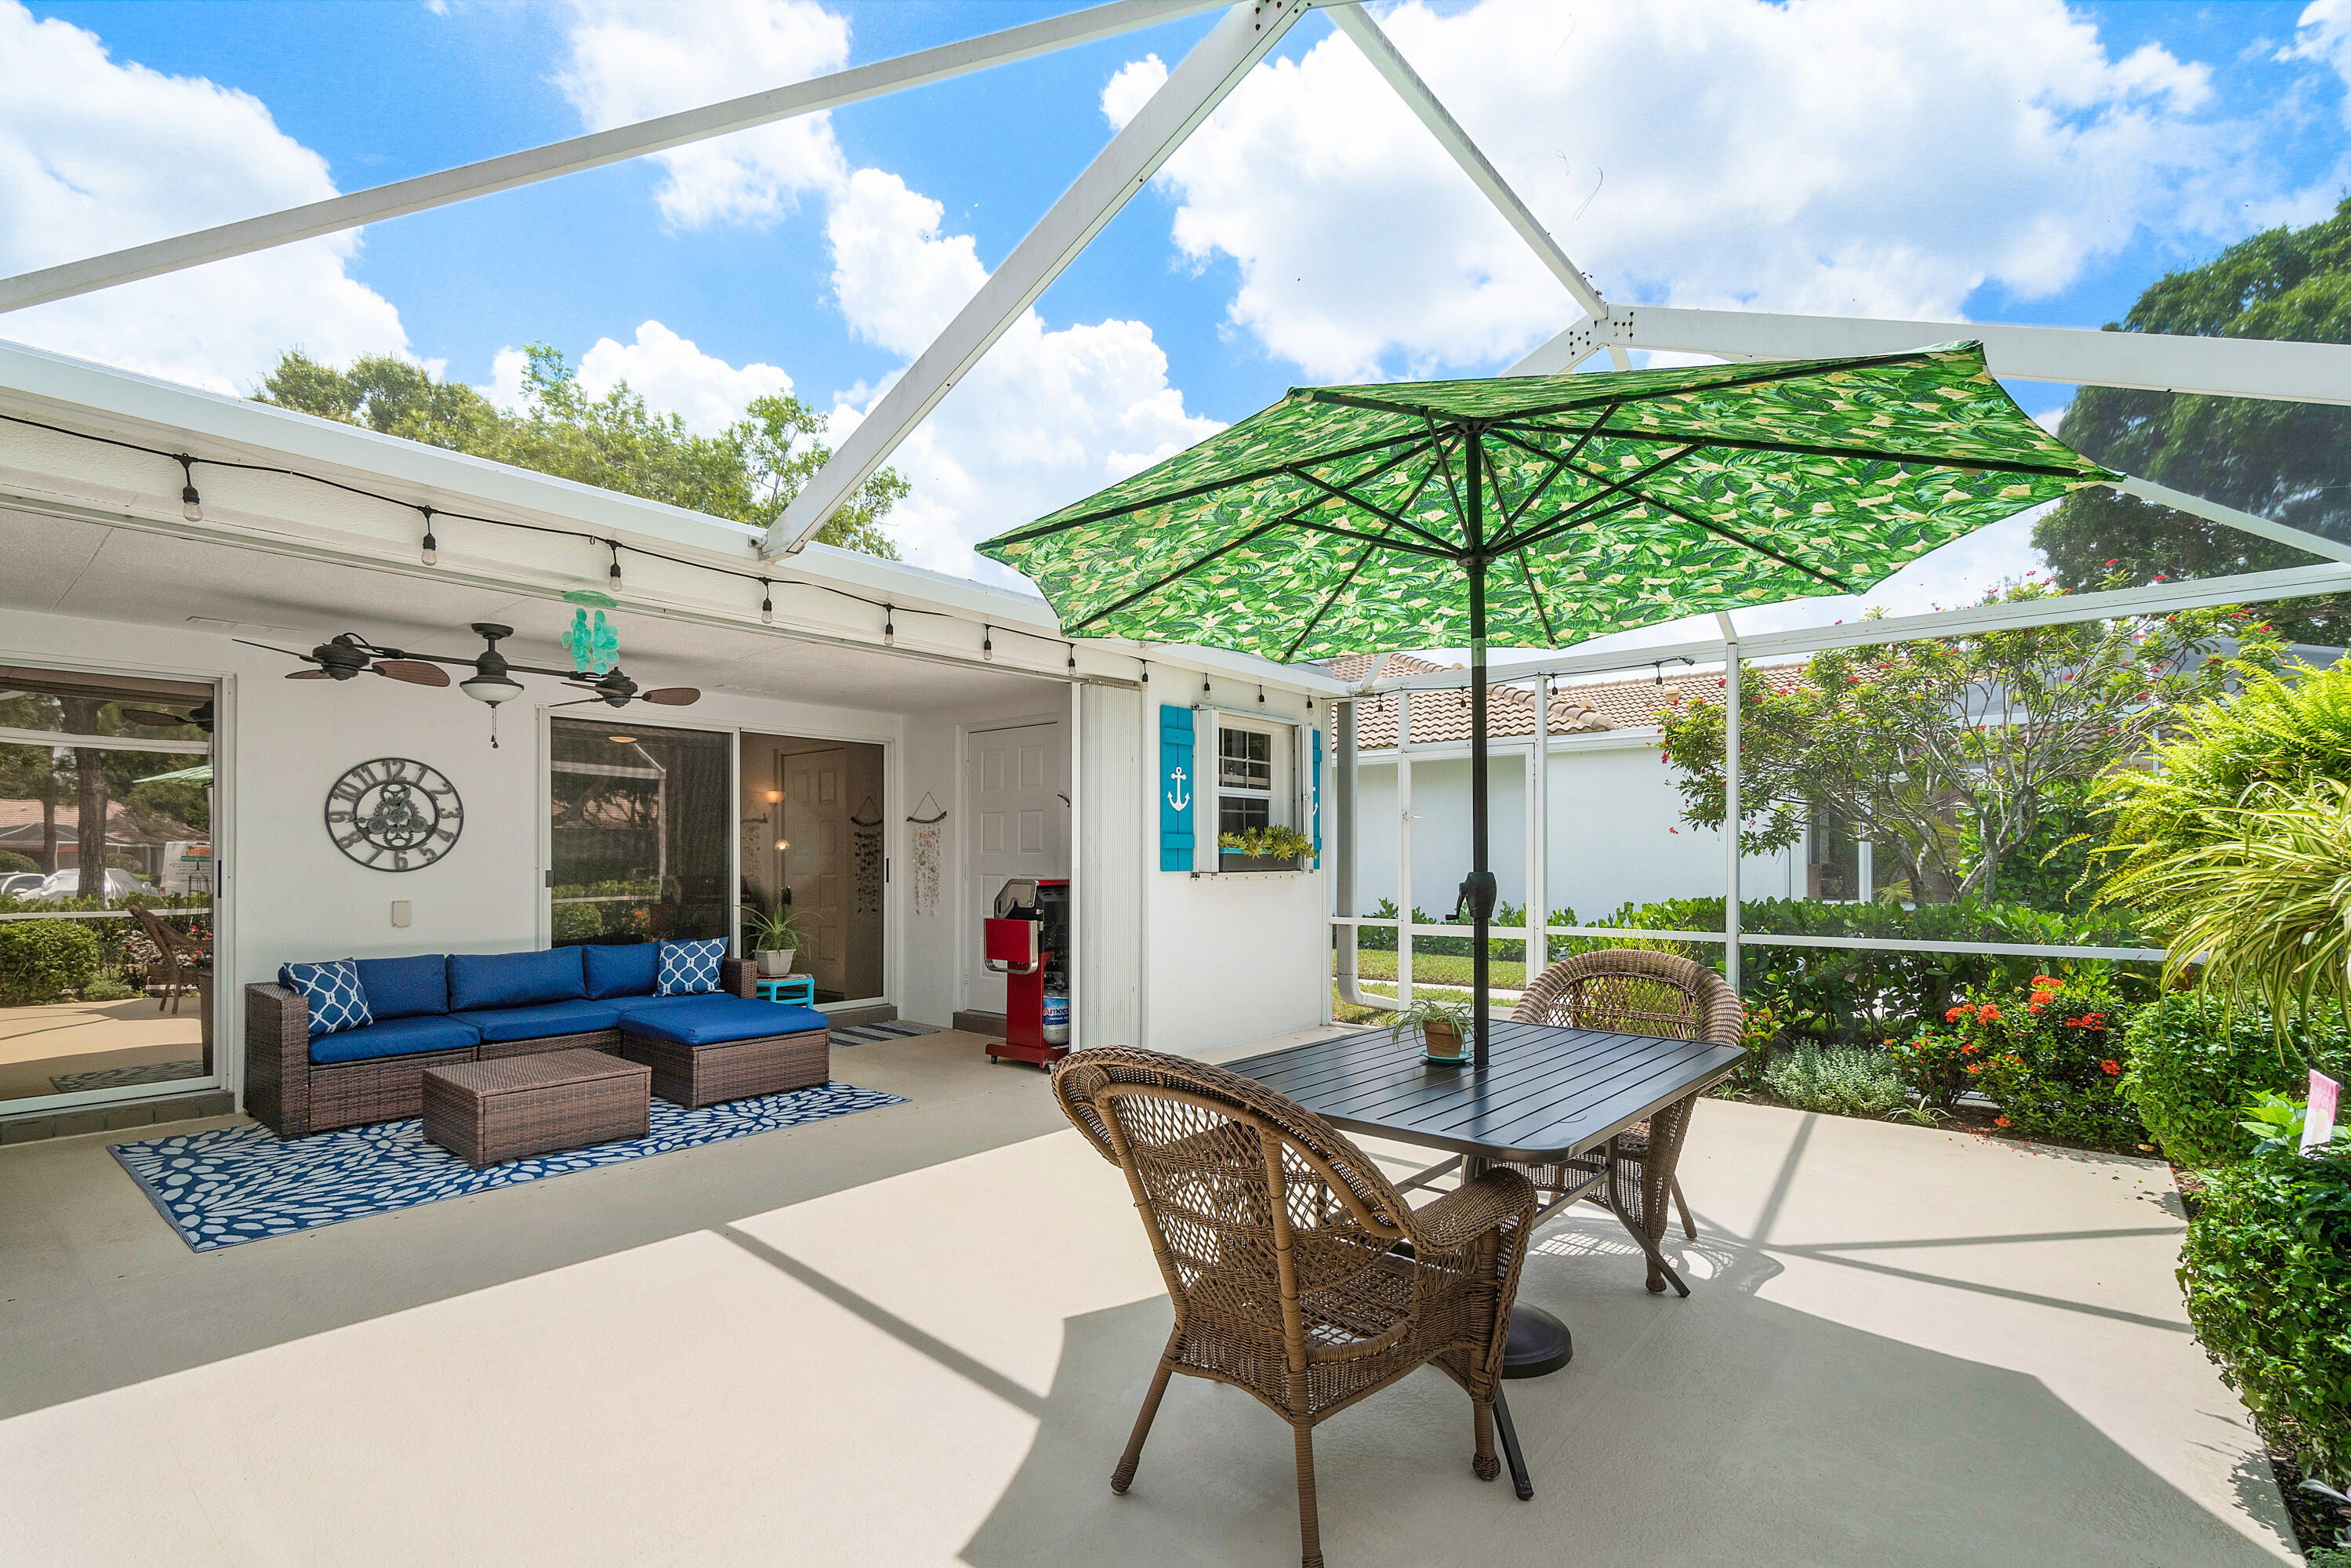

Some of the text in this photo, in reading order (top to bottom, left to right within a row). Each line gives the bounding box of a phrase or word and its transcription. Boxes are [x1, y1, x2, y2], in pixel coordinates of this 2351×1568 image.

[353, 764, 379, 787] 11
[382, 760, 407, 780] 12
[416, 767, 430, 784] 1
[333, 782, 363, 803] 10
[430, 783, 453, 800] 2
[328, 811, 355, 823] 9
[439, 808, 461, 818] 3
[338, 831, 364, 849] 8
[435, 828, 457, 842] 4
[365, 844, 383, 865] 7
[394, 850, 408, 870] 6
[417, 843, 437, 862] 5
